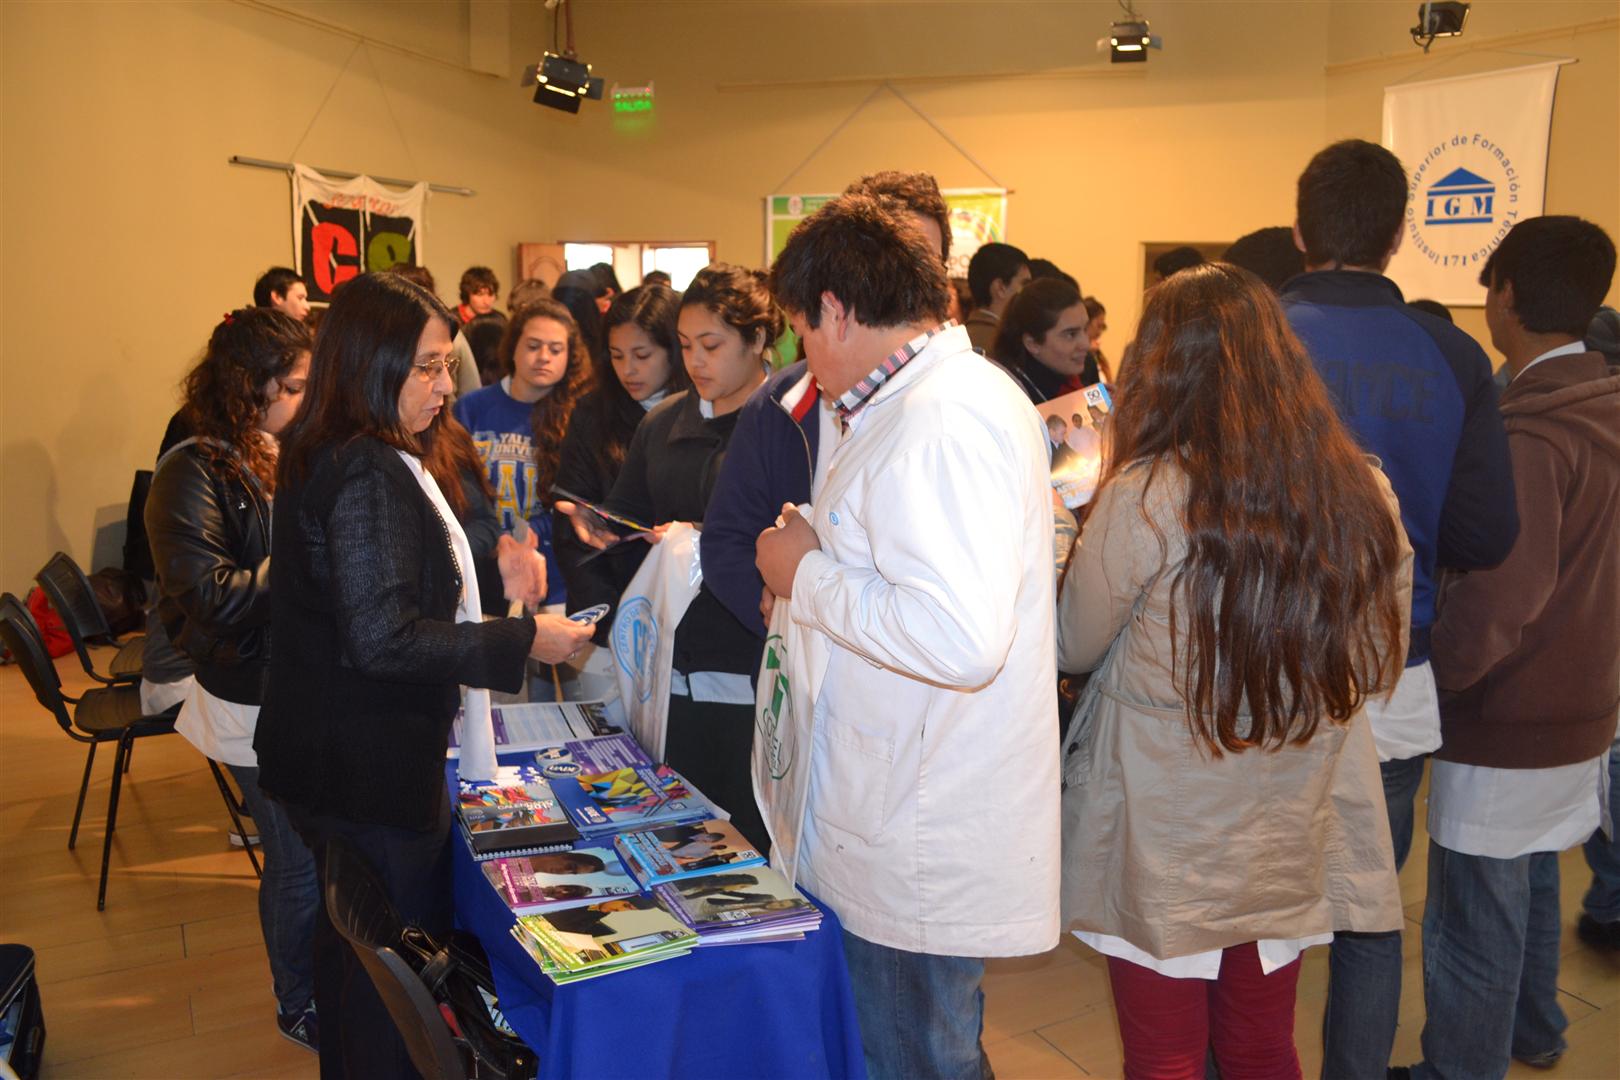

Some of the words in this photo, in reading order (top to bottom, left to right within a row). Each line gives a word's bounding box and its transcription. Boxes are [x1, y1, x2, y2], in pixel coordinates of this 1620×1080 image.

[1451, 135, 1467, 146] de
[1472, 134, 1521, 203] Formación
[1426, 195, 1493, 217] IGM
[1443, 255, 1467, 266] 171
